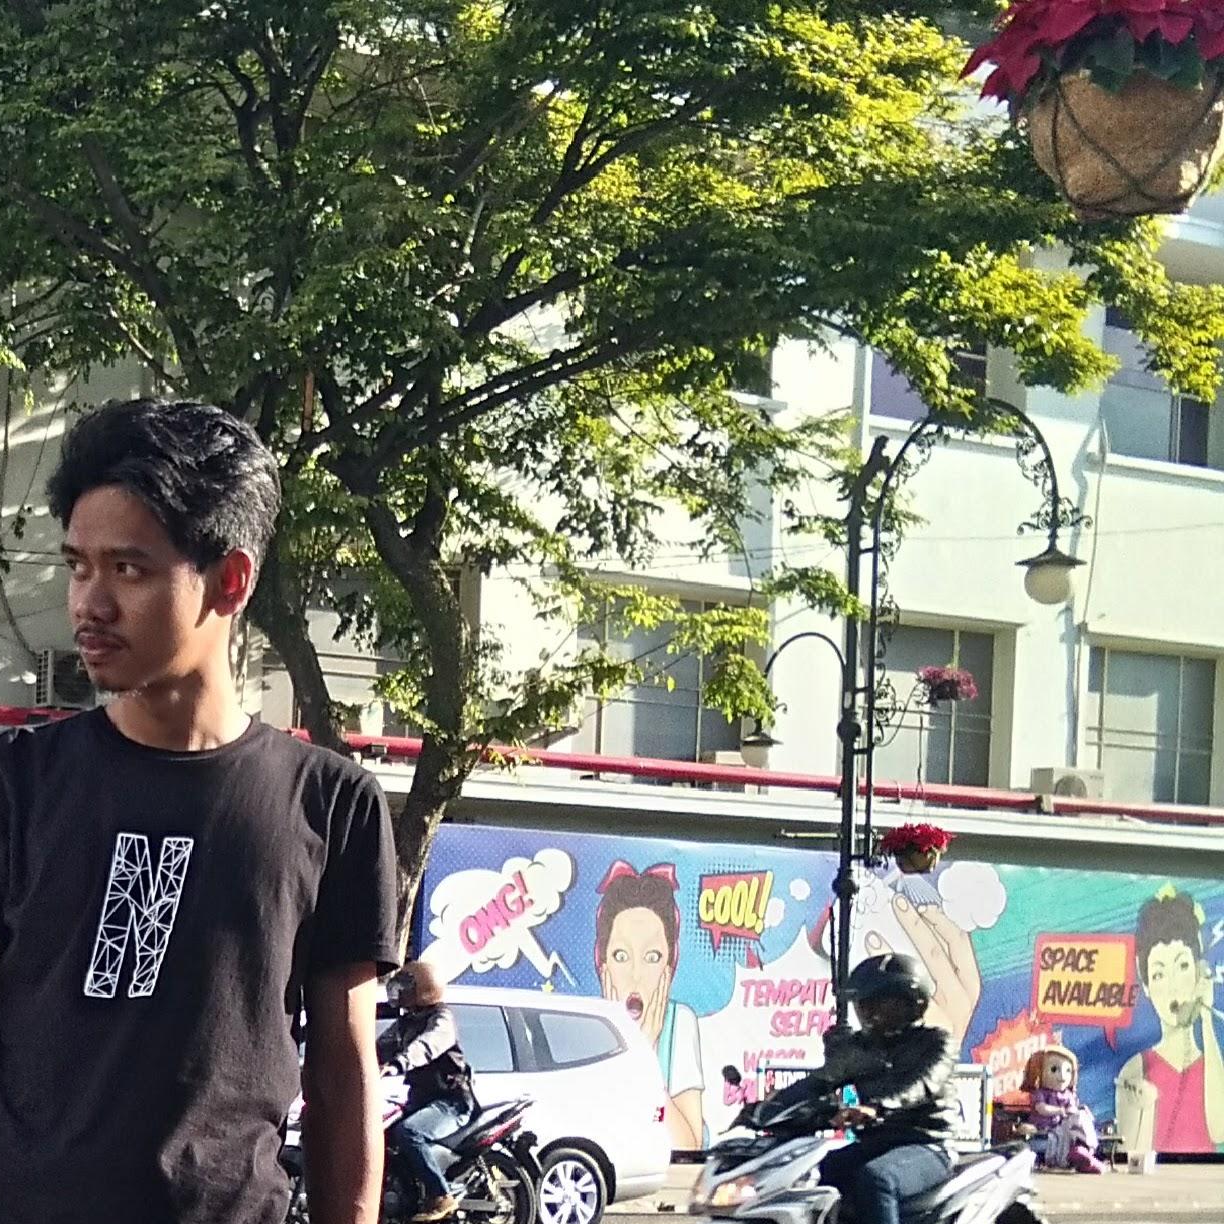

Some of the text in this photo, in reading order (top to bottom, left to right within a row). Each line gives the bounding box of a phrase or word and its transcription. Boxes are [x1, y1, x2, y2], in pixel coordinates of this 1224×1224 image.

[459, 870, 534, 954] OMG!
[698, 871, 774, 934] COOL!
[1040, 946, 1099, 973] SPACE
[740, 978, 832, 1008] TEMPAT
[1042, 980, 1140, 1008] AVAILABLE
